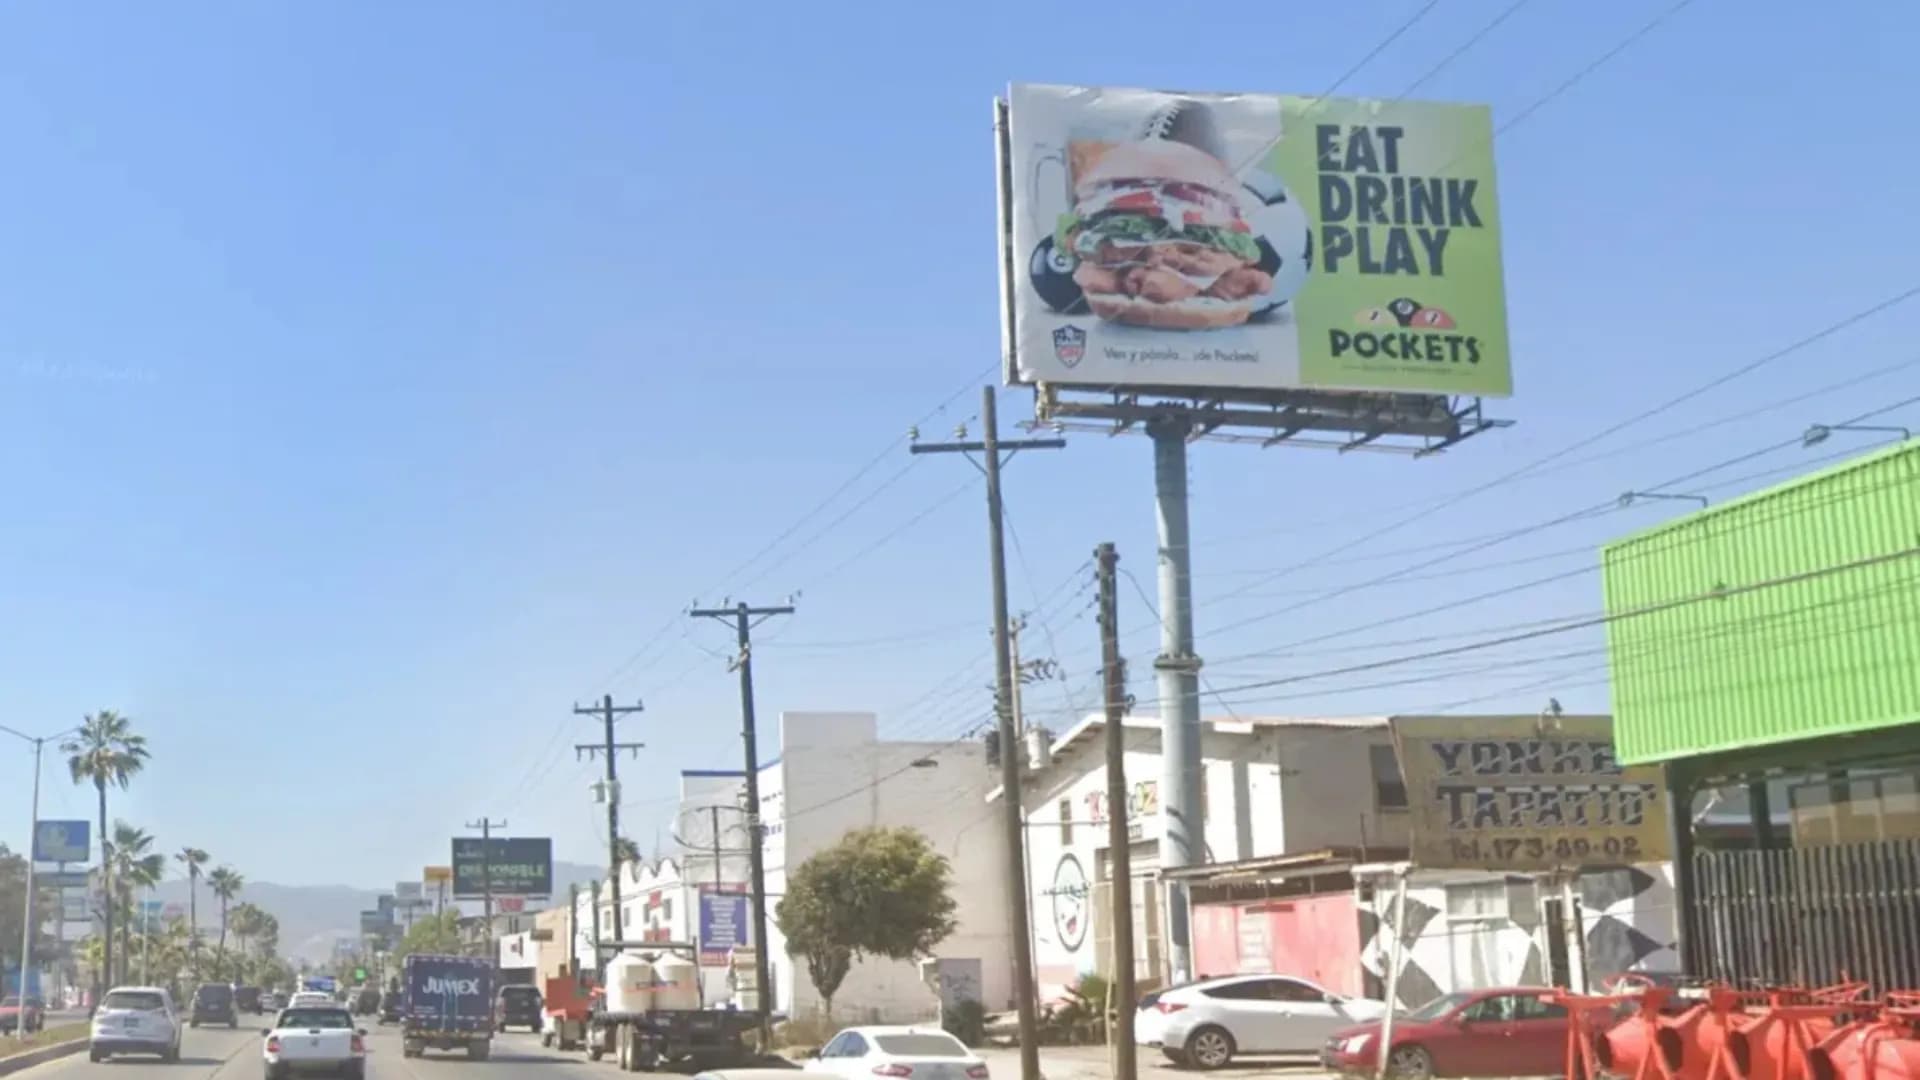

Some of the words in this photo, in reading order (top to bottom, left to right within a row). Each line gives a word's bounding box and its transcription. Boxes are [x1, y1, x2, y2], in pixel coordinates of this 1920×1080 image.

[1316, 124, 1404, 173] EAT
[1319, 175, 1483, 228] DRINK
[1322, 225, 1450, 277] PLAY
[1128, 350, 1137, 364] y
[1329, 328, 1481, 364] POCKETS
[422, 976, 480, 996] JUMEX
